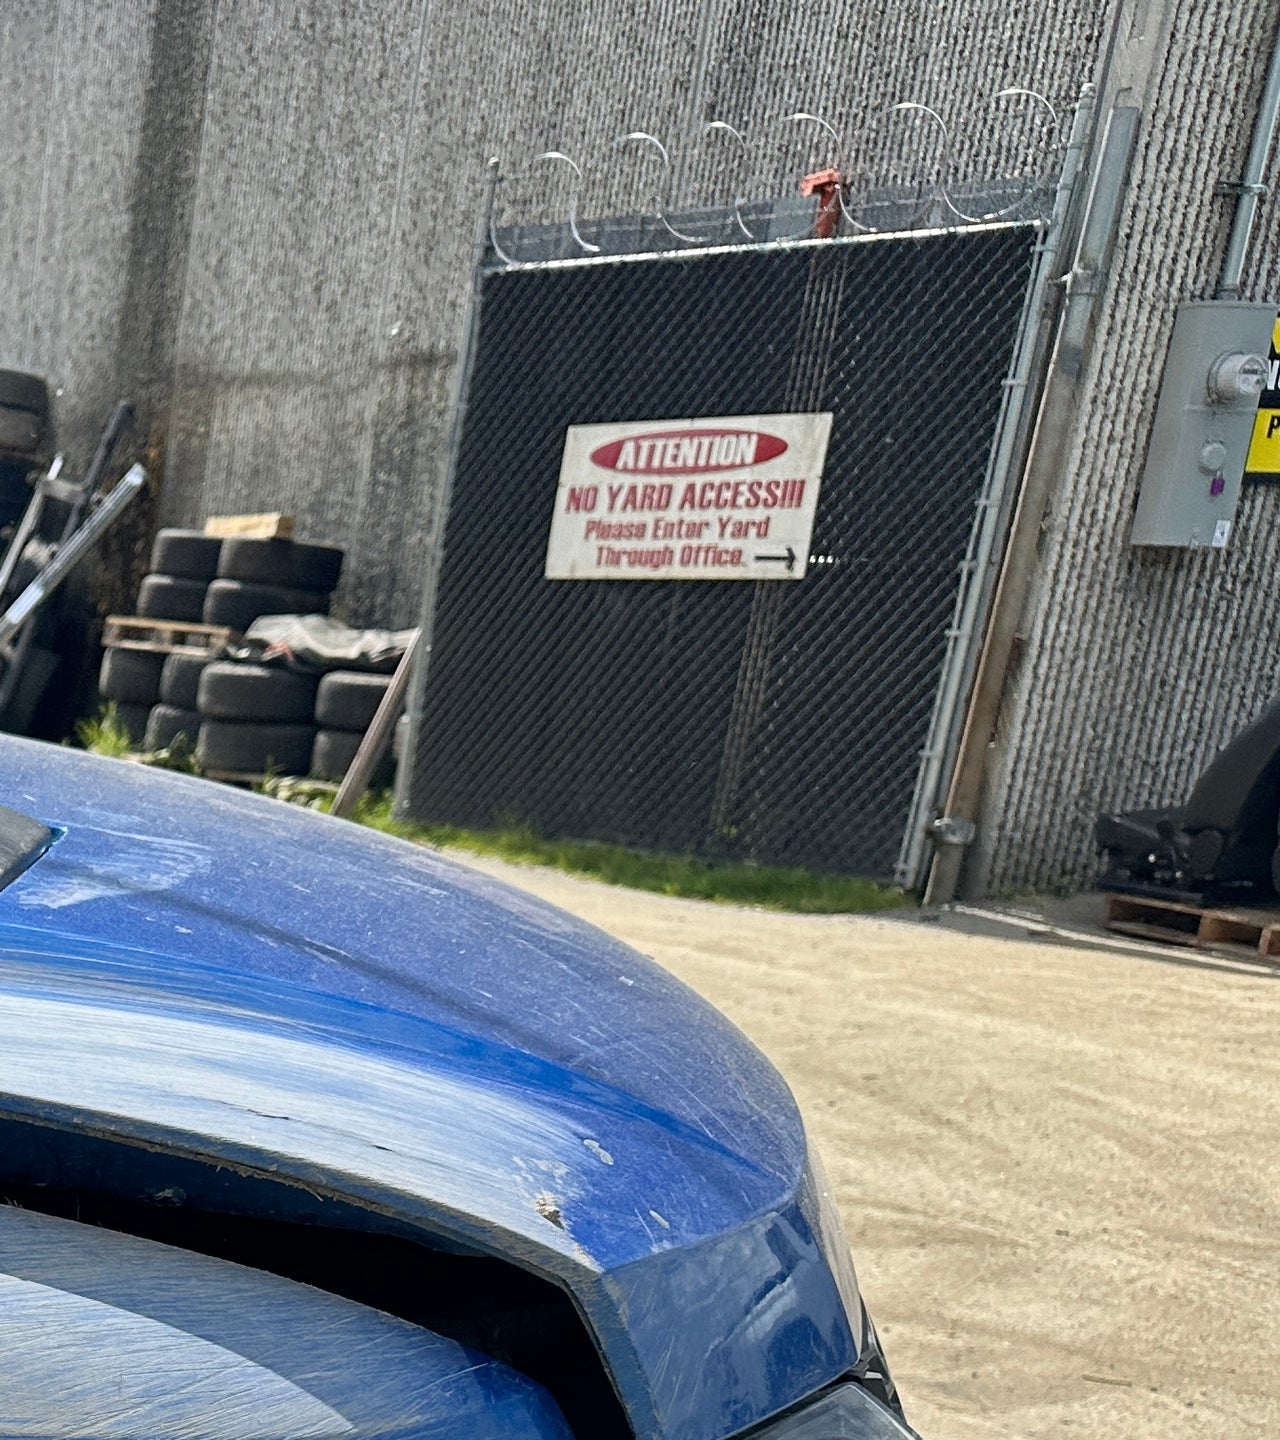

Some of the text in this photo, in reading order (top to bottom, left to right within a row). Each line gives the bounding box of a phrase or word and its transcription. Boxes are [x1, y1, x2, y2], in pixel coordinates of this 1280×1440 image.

[615, 434, 758, 470] ATTENTION
[565, 479, 806, 513] NO YARD ACCESS!!!
[584, 516, 770, 540] Please Enter Yard
[596, 546, 673, 570] Through
